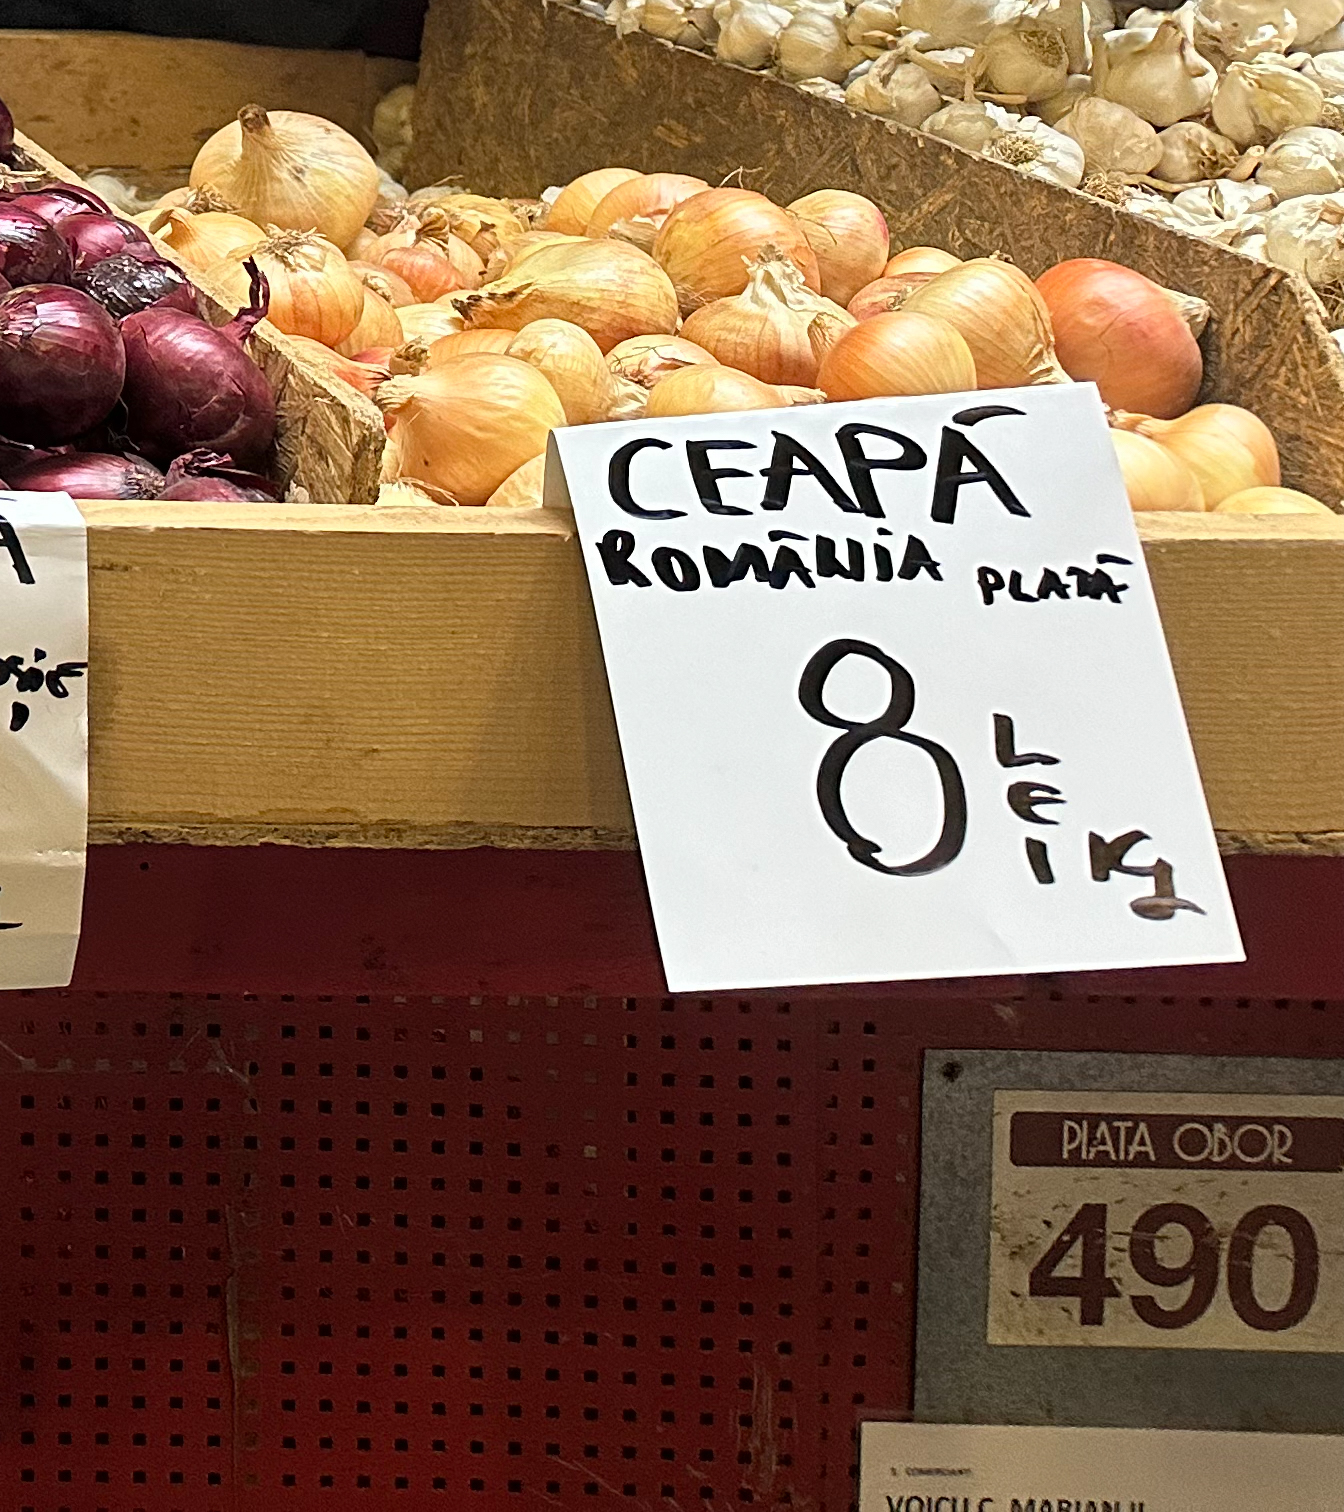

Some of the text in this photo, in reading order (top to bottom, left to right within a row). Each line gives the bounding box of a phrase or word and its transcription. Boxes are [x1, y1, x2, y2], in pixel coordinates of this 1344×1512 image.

[797, 638, 968, 877] 8
[1061, 1120, 1293, 1165] PIATA OBOR
[1029, 1202, 1320, 1332] 490
